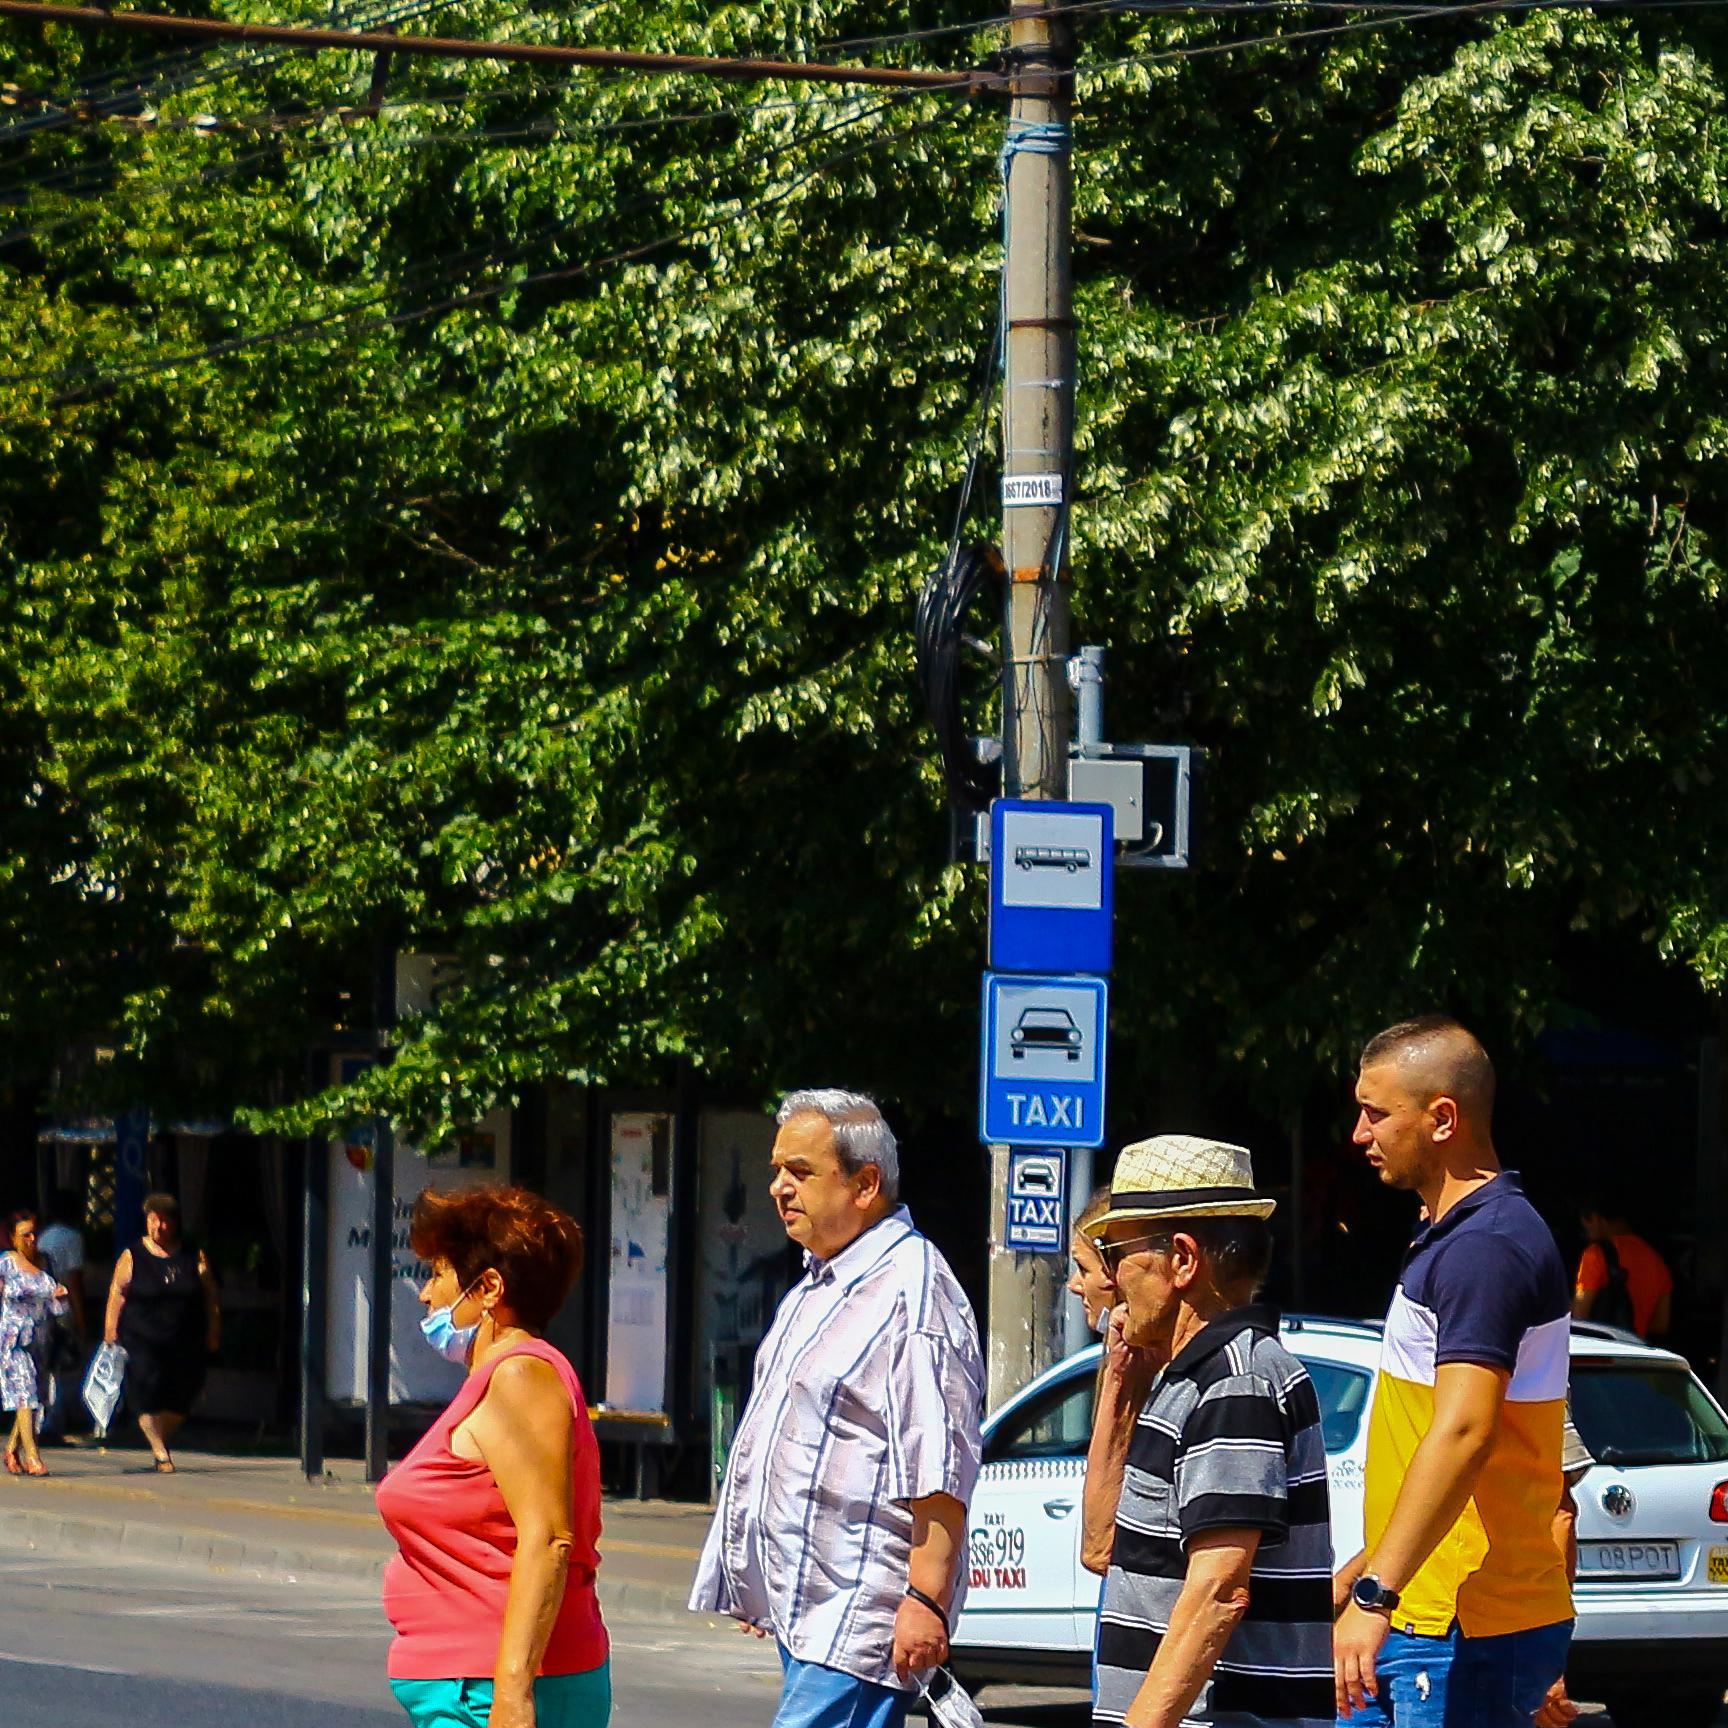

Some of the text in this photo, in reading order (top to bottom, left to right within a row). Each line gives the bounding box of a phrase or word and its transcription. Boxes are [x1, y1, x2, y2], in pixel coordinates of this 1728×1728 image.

[1007, 1093, 1084, 1129] TAXI
[1010, 1199, 1061, 1224] TAXI
[996, 1527, 1025, 1566] 919
[1629, 1546, 1673, 1570] POT
[994, 1568, 1026, 1589] TAXI
